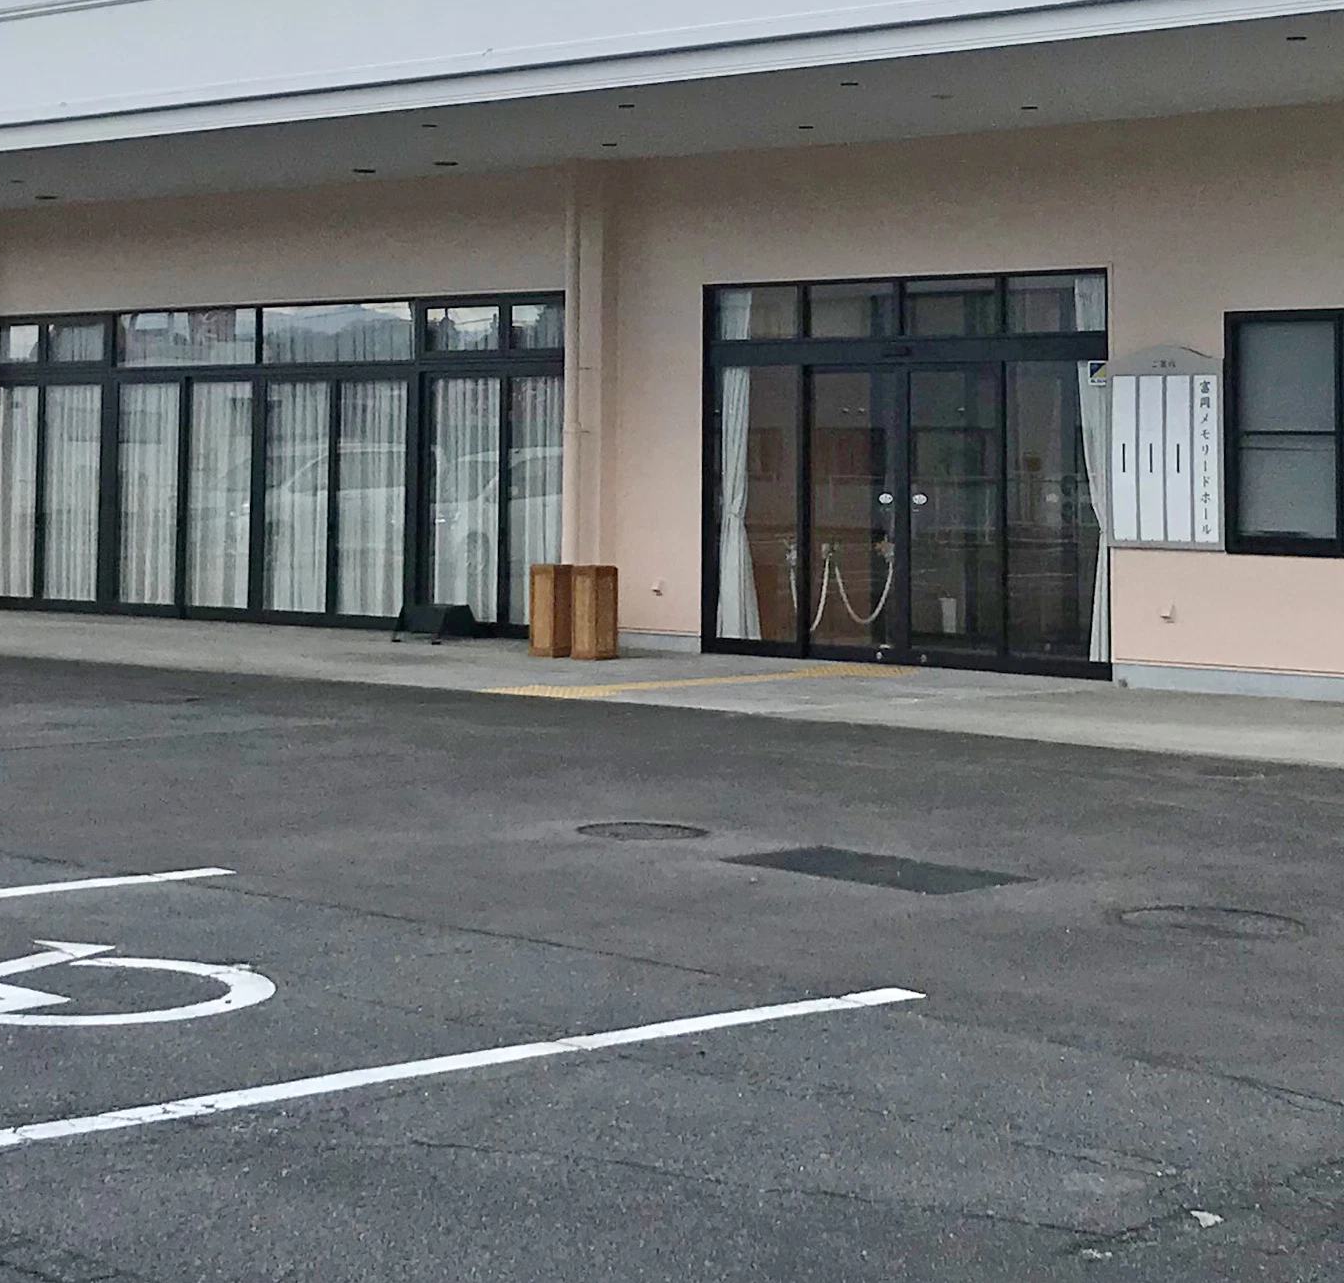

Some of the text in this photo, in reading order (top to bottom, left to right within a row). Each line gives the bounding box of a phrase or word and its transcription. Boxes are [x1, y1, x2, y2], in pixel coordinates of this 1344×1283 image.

[1199, 379, 1212, 535] 富岡メモリードホール
